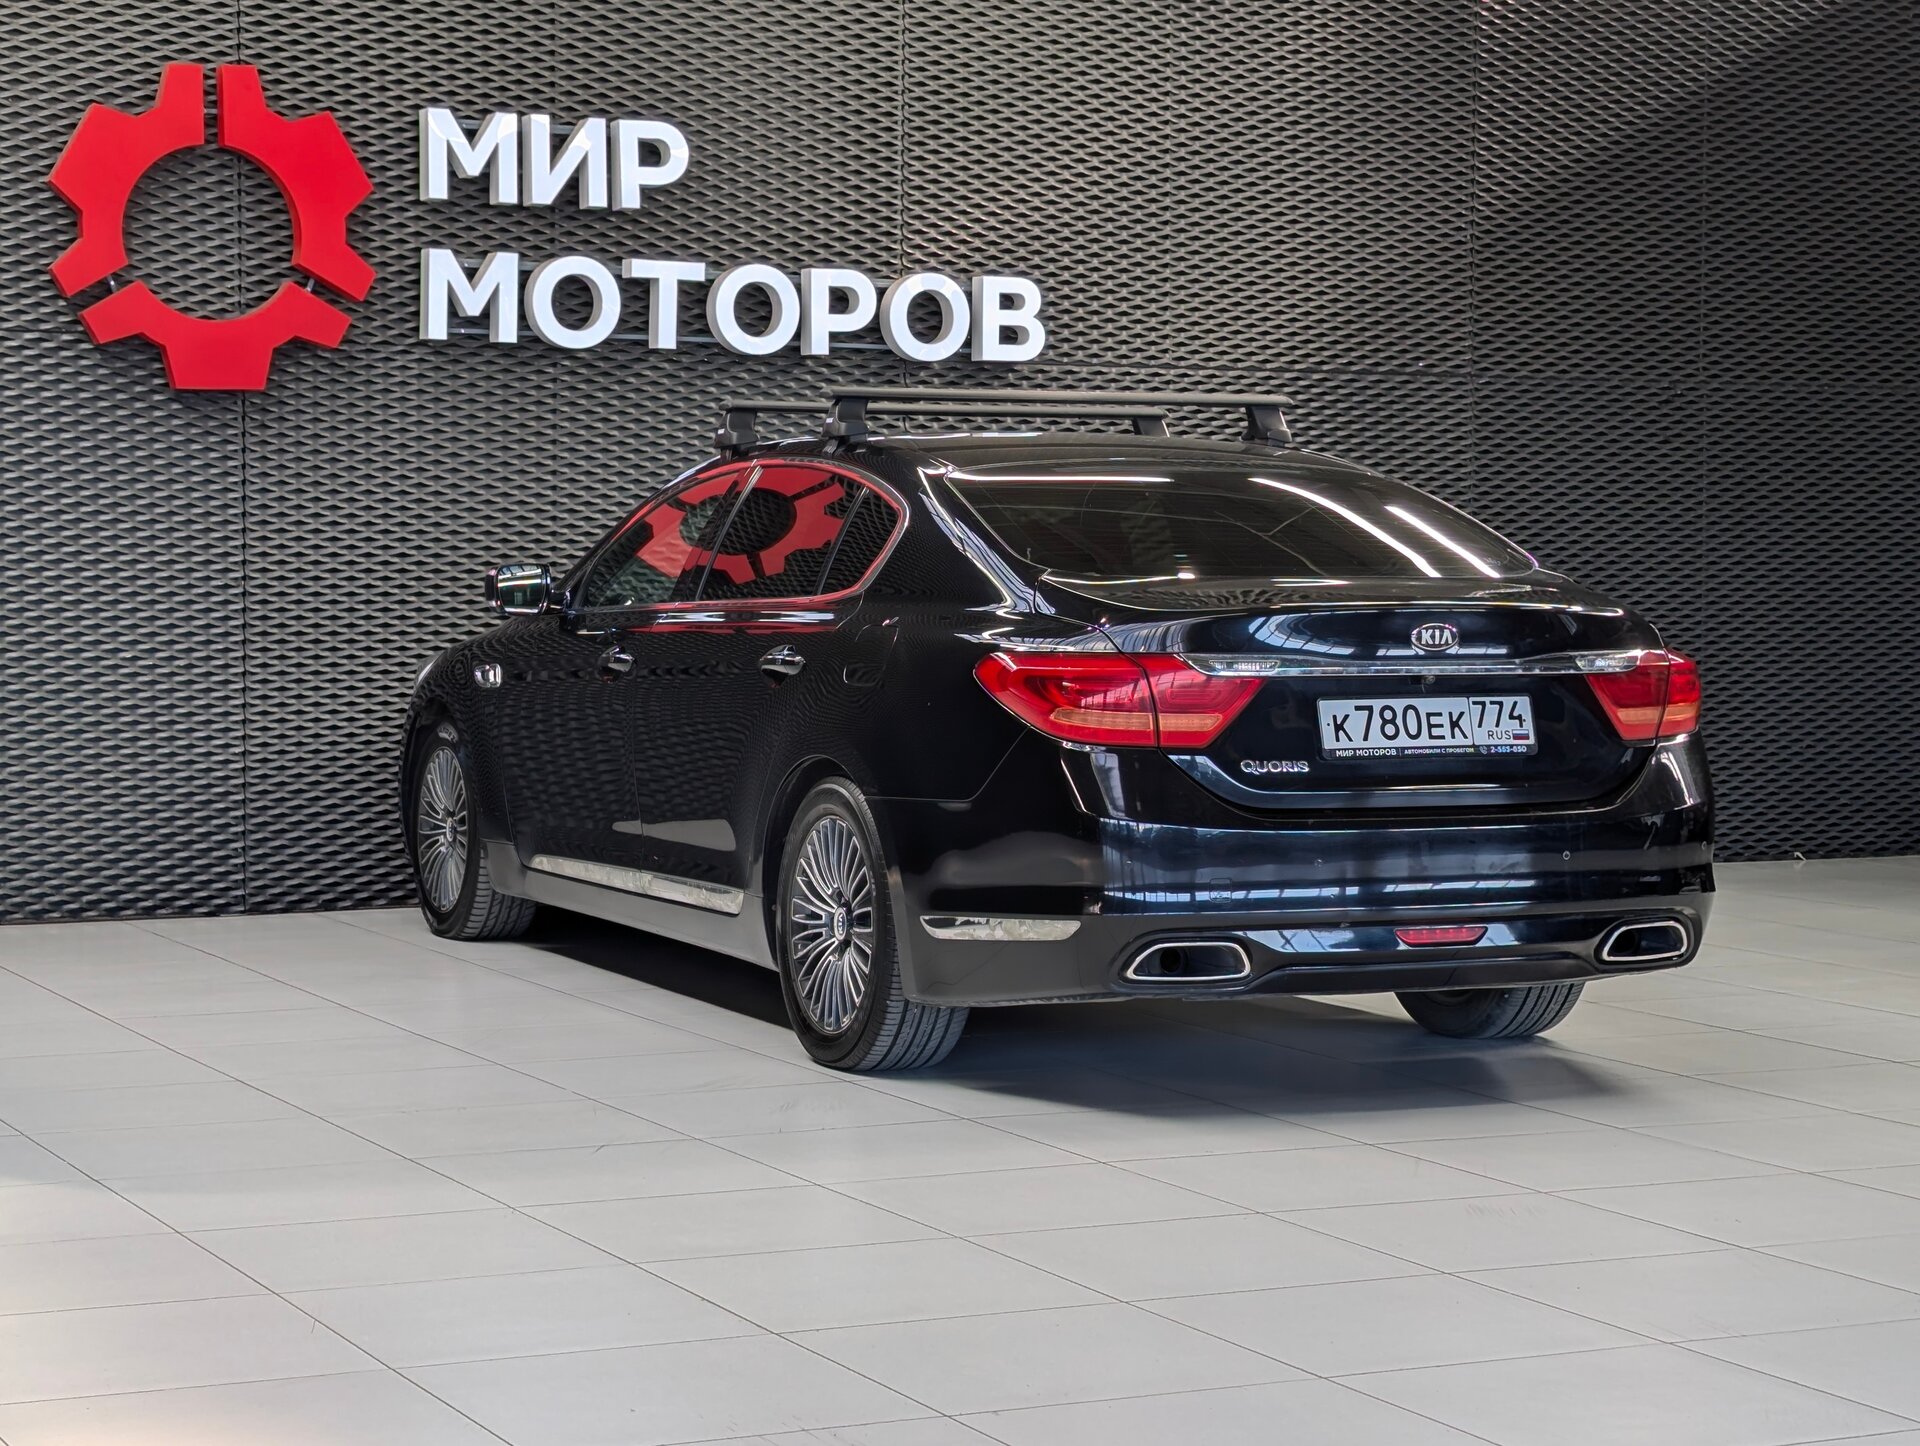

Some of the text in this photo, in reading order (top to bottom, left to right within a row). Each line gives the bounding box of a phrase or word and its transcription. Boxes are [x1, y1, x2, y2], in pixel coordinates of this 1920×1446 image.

[419, 106, 690, 210] МИР
[419, 247, 1046, 363] МОТОРОВ
[1421, 629, 1453, 645] KIA
[1332, 700, 1525, 742] К780ЕК 774
[1487, 730, 1512, 741] RUS
[1335, 749, 1354, 757] МИР
[1356, 748, 1397, 757] МОТОРОВ
[1240, 759, 1310, 775] QUORIS
